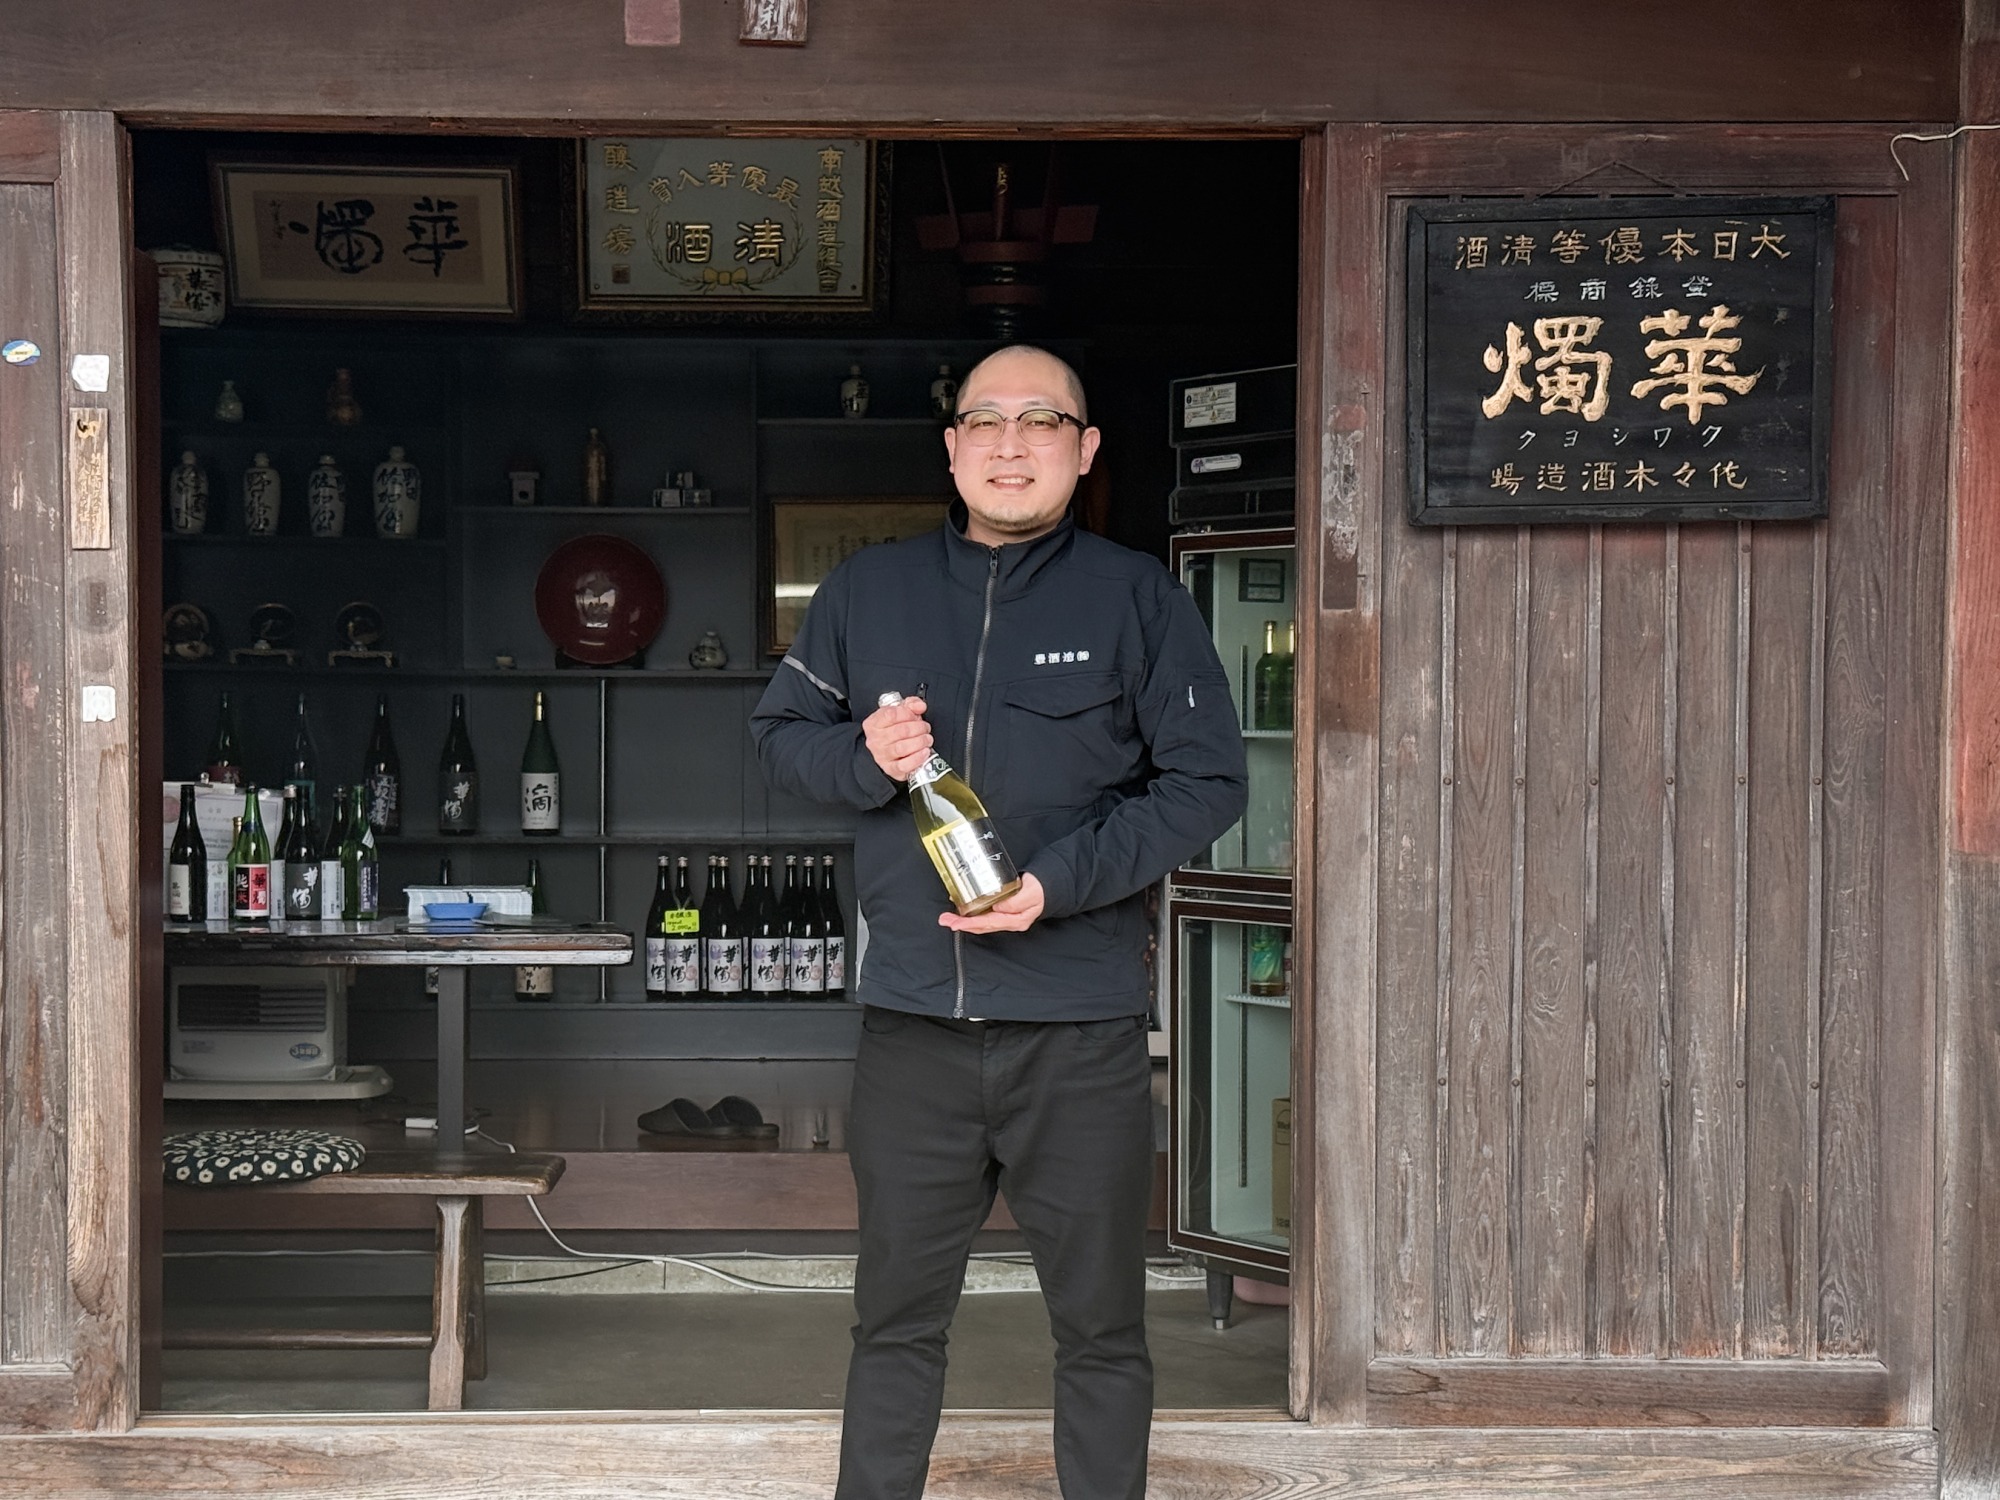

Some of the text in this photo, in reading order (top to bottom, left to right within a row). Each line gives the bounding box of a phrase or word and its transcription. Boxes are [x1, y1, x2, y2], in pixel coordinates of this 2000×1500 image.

[666, 217, 786, 266] 清酒
[1455, 224, 1792, 271] 大日本優等清酒
[1482, 303, 1767, 425] 華燭
